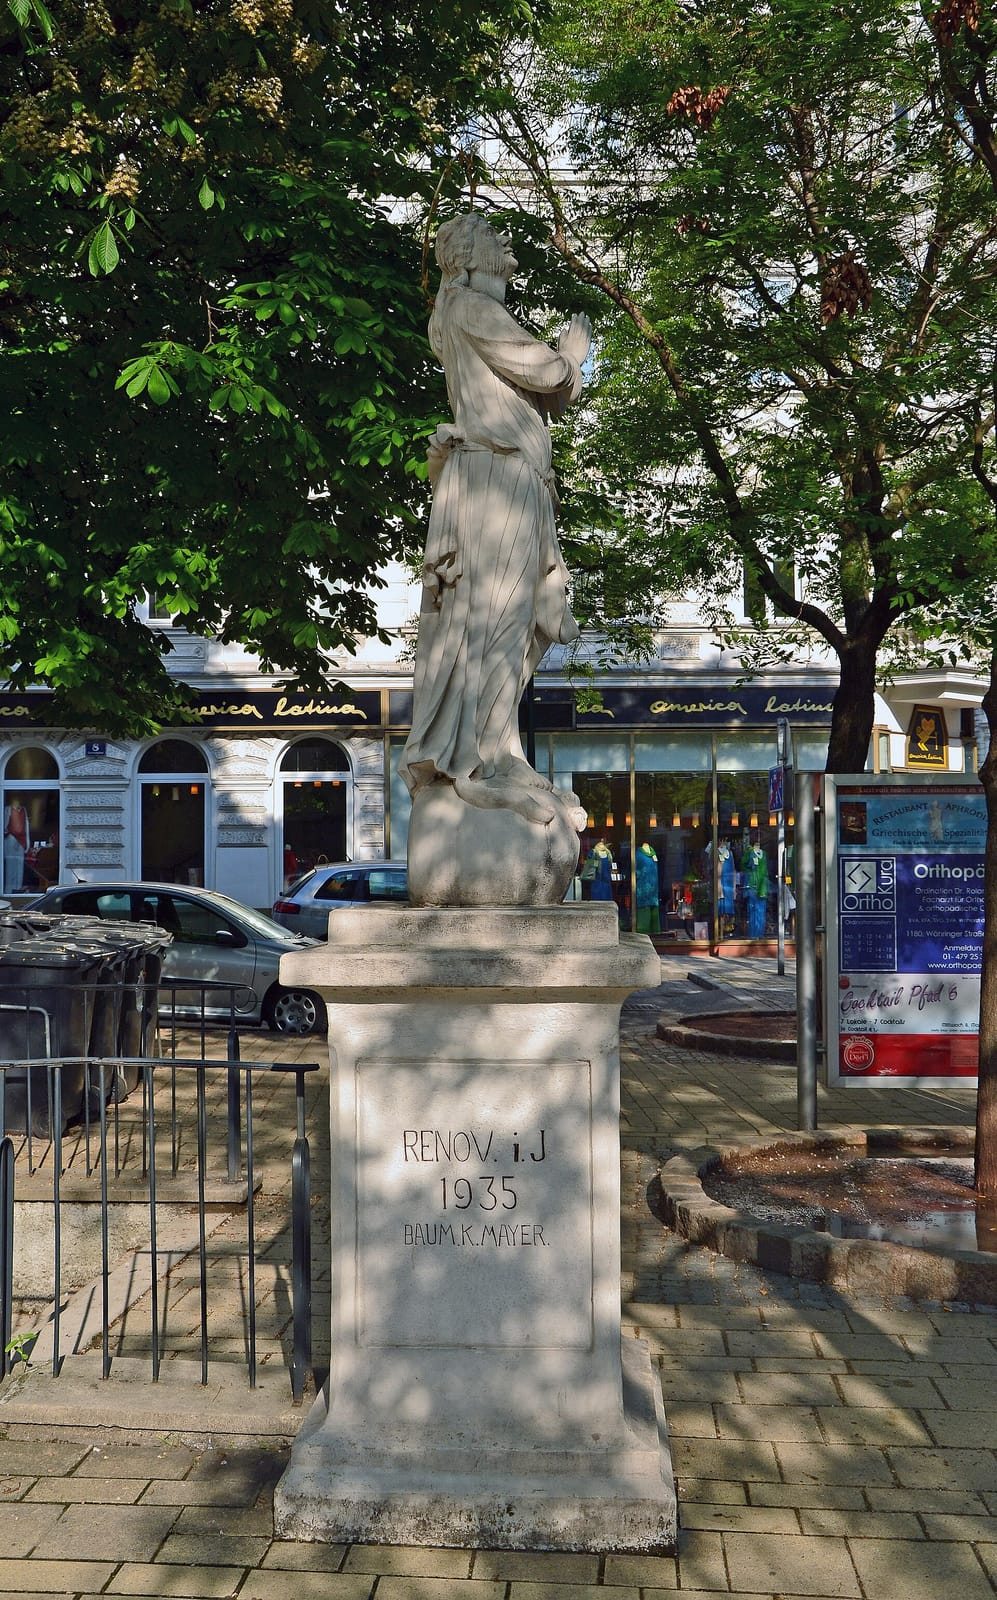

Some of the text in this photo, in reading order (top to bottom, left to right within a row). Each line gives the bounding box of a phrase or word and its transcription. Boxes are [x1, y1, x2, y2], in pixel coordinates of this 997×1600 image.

[174, 696, 367, 720] merica latina
[650, 700, 748, 715] america
[92, 743, 100, 752] 8
[872, 802, 928, 826] RESTAURANT
[872, 828, 928, 837] Griechische
[844, 894, 894, 910] Ortho
[840, 986, 904, 1012] Cocktail
[908, 984, 944, 1010] Pfad
[403, 1130, 498, 1163] RENOV.
[440, 1176, 518, 1210] 1935
